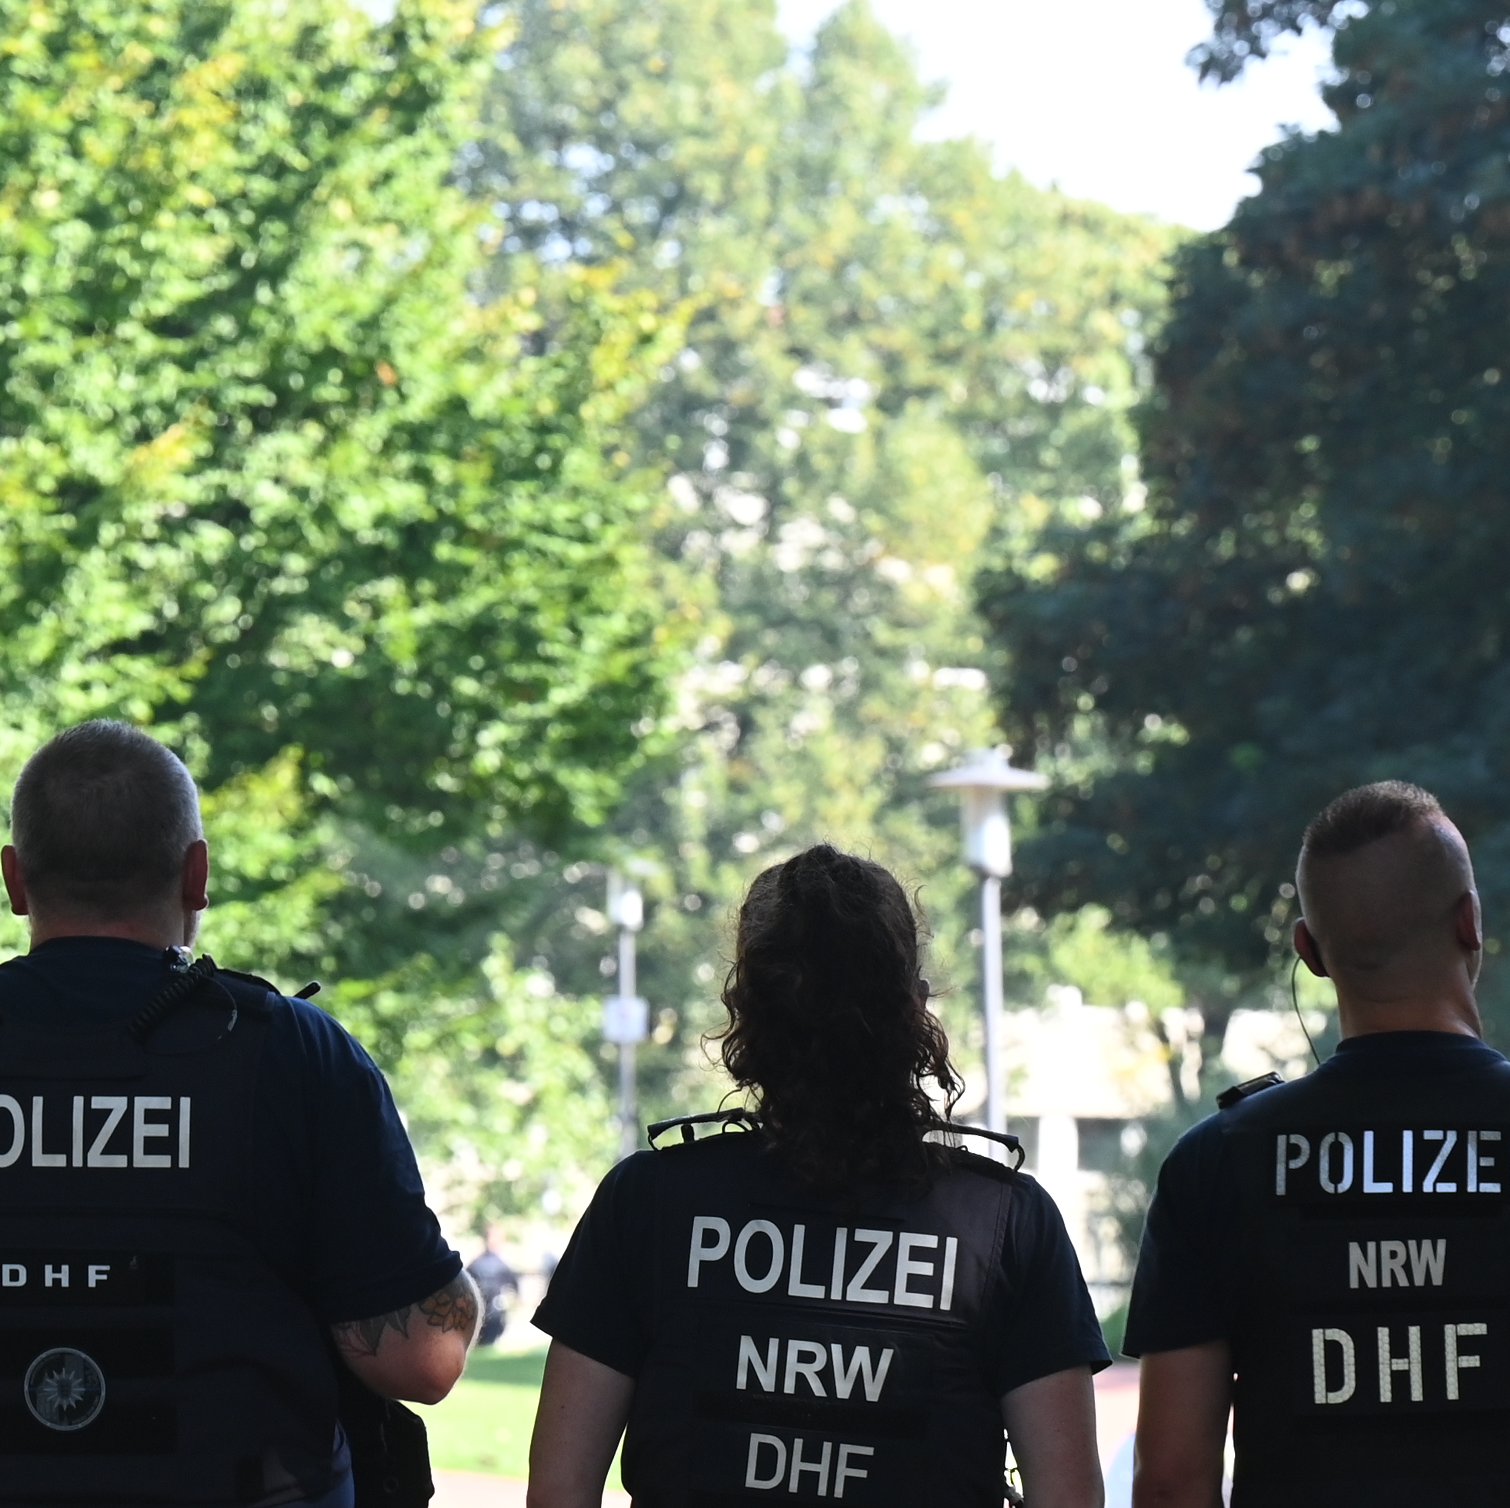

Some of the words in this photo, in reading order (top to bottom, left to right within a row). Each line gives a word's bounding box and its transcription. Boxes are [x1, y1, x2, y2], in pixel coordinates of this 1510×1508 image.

[687, 1215, 959, 1311] POLIZEI
[1348, 1238, 1448, 1289] NRW
[735, 1334, 895, 1403] NRW
[1311, 1322, 1489, 1405] DHF
[744, 1432, 876, 1499] DHF
